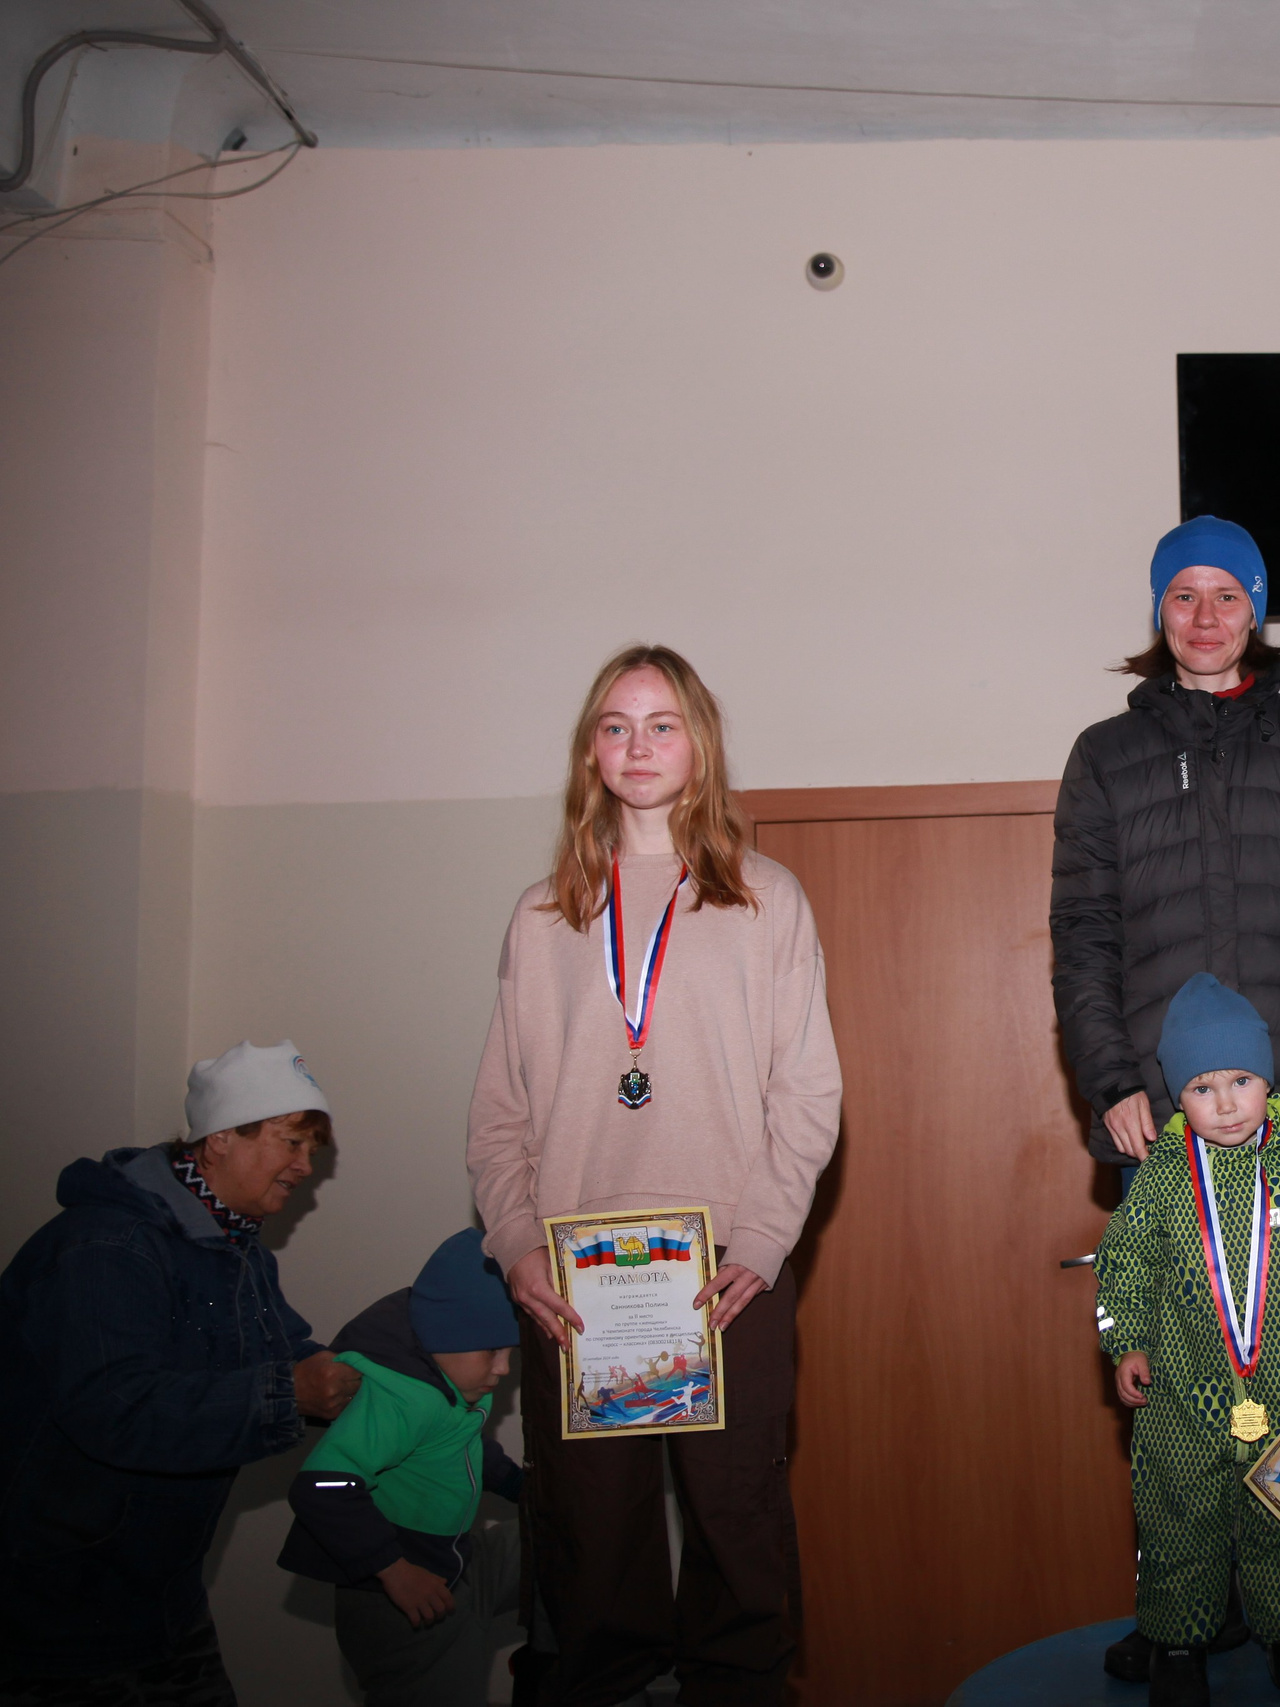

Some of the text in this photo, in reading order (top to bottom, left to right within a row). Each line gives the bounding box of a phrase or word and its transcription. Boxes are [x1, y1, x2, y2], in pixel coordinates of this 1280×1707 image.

[1180, 761, 1190, 790] Reebok
[599, 1271, 671, 1286] ГРАМОТА
[610, 1301, 668, 1310] Санникова Полина
